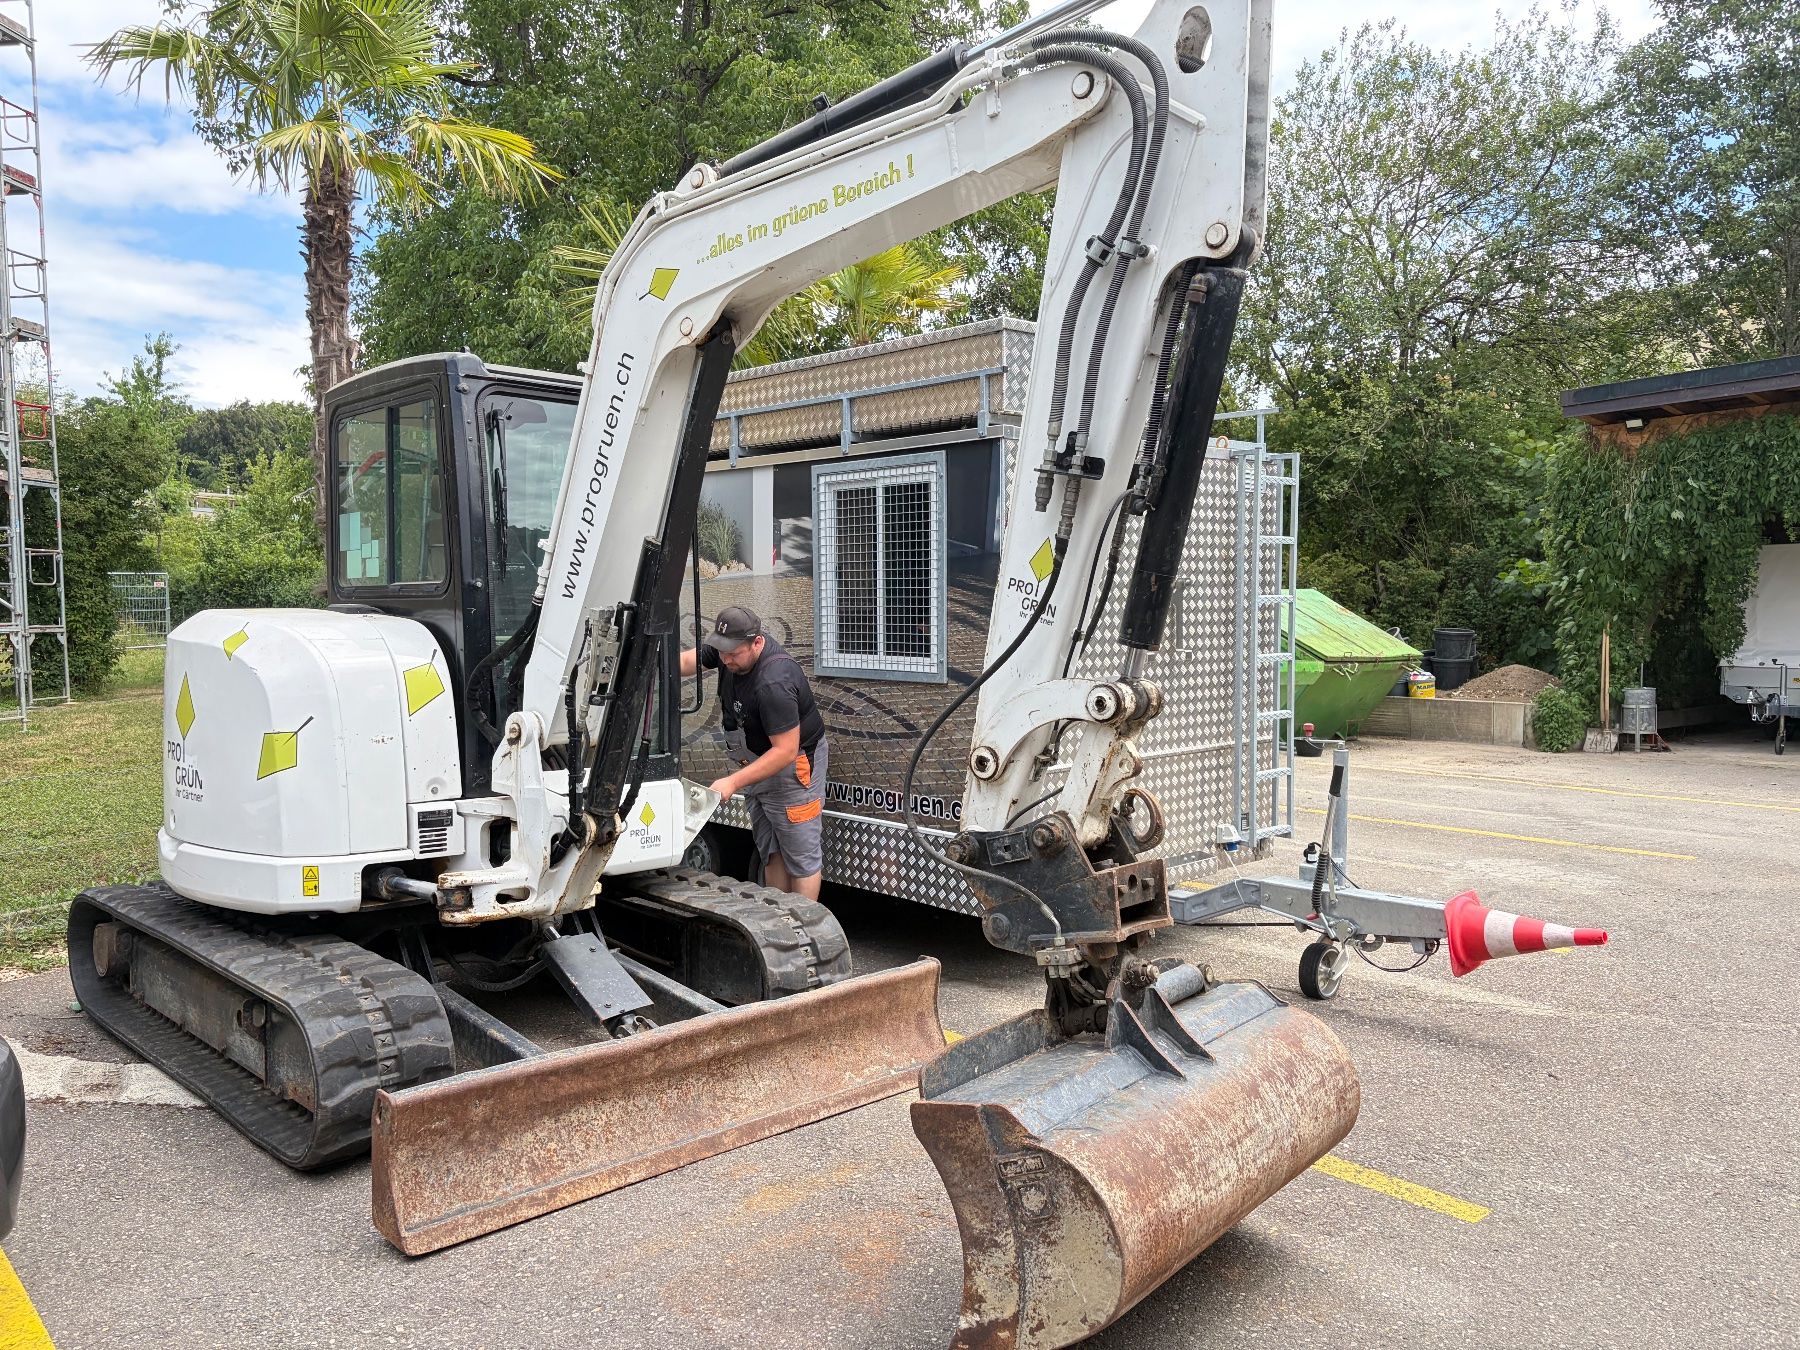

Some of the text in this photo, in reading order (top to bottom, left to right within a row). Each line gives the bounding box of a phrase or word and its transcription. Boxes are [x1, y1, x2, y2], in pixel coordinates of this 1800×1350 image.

[697, 233, 744, 265] ...alles
[747, 224, 768, 243] im
[772, 198, 829, 238] grüene
[832, 161, 901, 208] Bereich
[562, 351, 635, 600] www.progruen.ch
[1008, 577, 1034, 596] PRO
[1021, 597, 1057, 618] GRN
[167, 740, 182, 763] PRO
[175, 764, 203, 790] GRÜN
[629, 828, 646, 837] PRO
